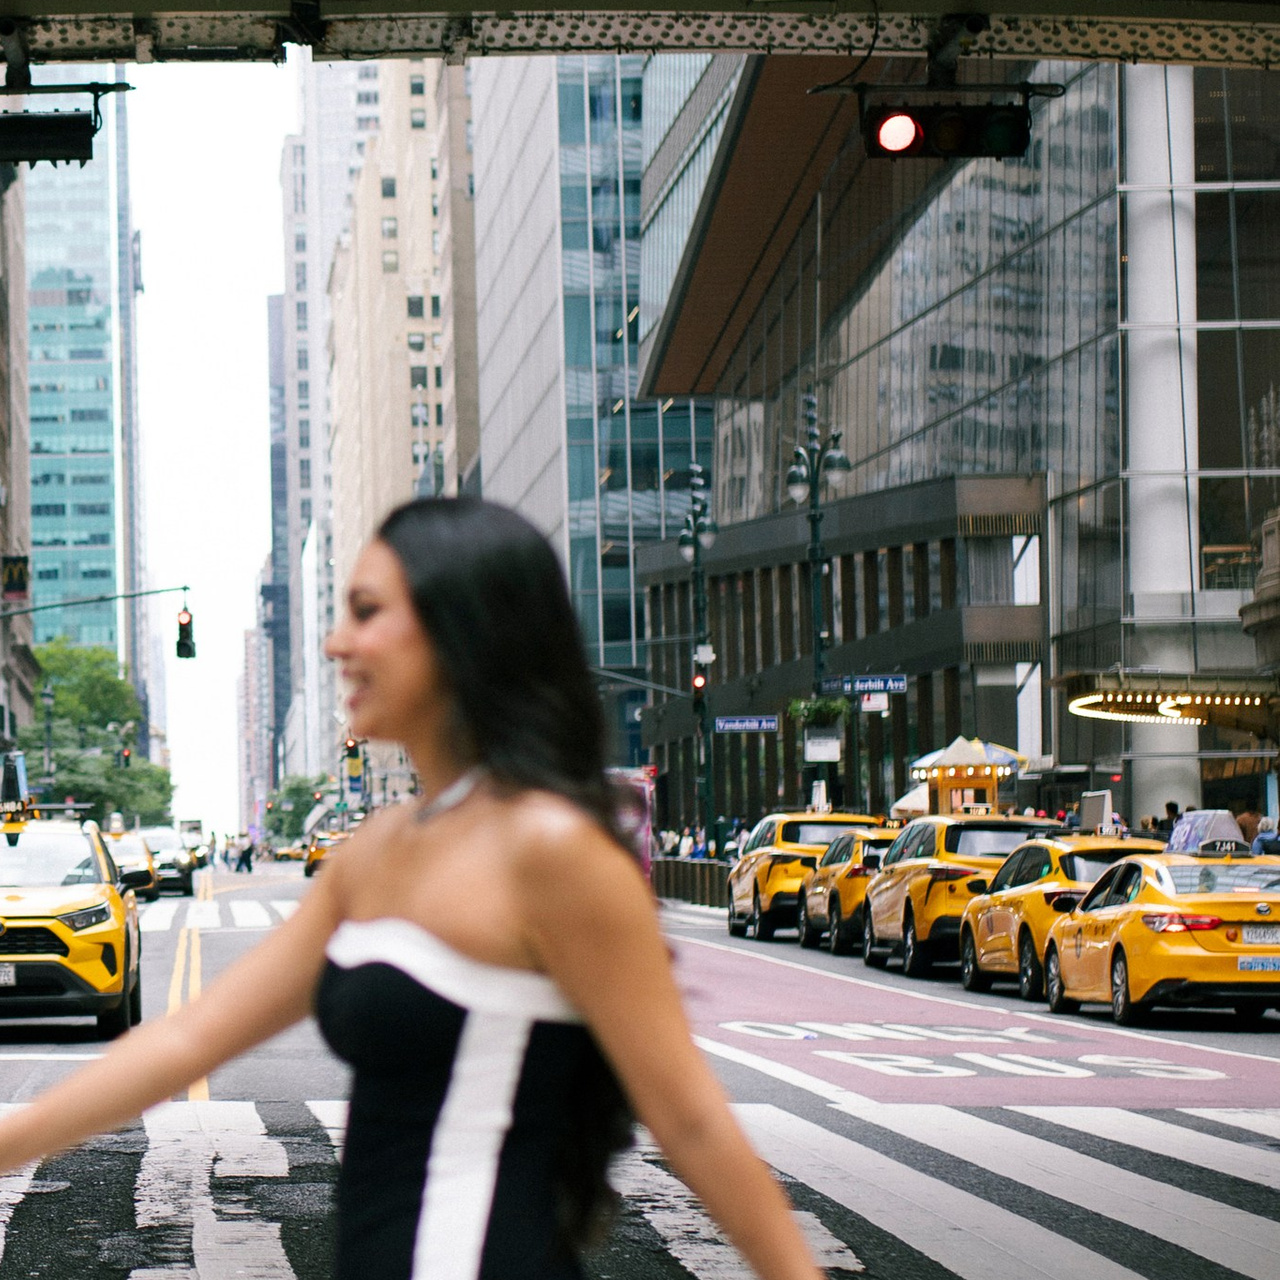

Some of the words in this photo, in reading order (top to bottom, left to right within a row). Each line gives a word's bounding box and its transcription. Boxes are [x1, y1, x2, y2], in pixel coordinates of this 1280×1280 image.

[886, 678, 905, 690] Ave
[760, 719, 775, 730] Ave
[1215, 841, 1236, 852] 7J41
[718, 1021, 1057, 1044] ONLY
[812, 1051, 1229, 1081] BUS
